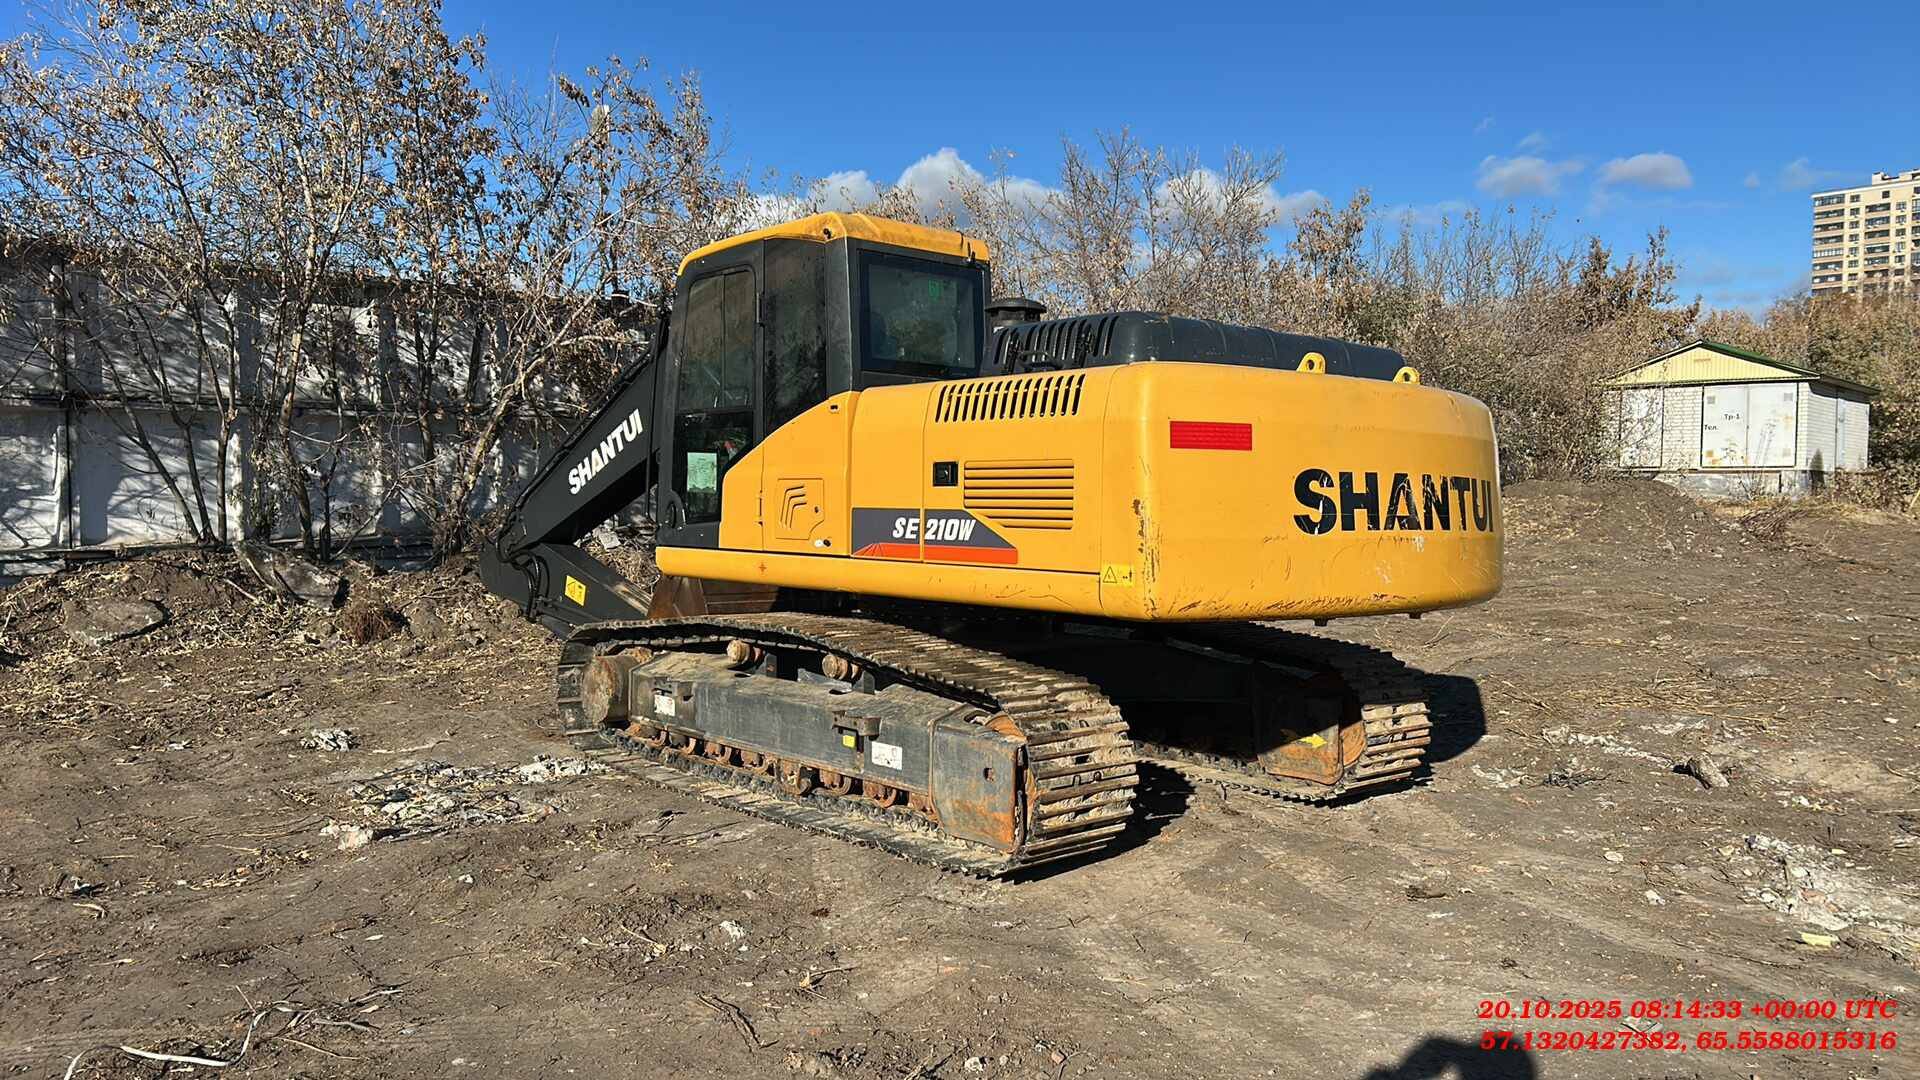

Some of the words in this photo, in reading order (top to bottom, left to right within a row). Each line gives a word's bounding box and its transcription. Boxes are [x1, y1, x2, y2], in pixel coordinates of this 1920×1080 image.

[568, 408, 644, 496] SHANTUI
[892, 516, 921, 540] SE
[923, 518, 977, 542] 210W
[1292, 467, 1494, 535] SHANTUI
